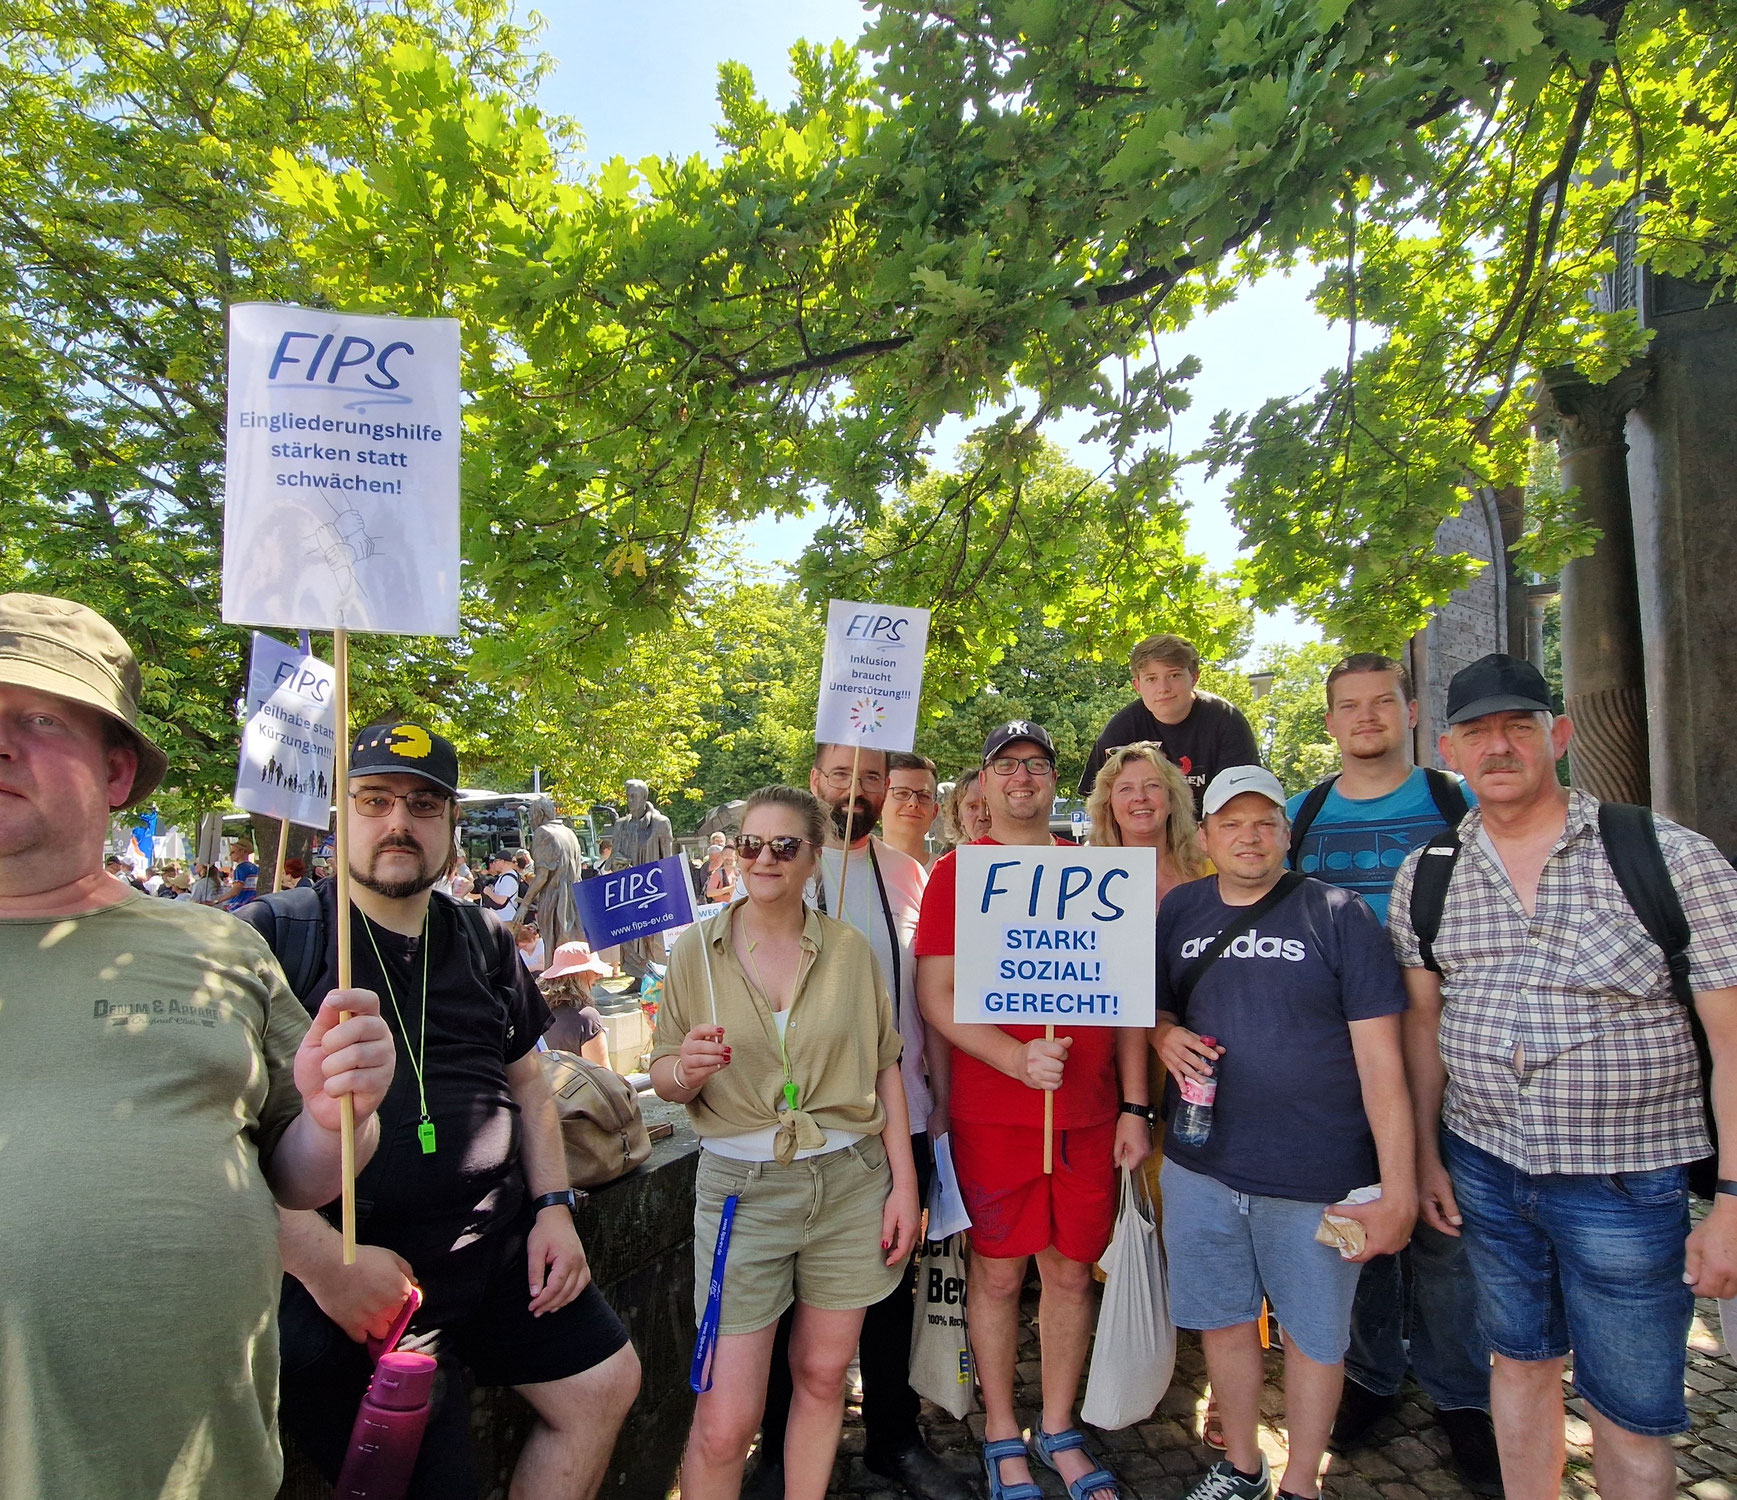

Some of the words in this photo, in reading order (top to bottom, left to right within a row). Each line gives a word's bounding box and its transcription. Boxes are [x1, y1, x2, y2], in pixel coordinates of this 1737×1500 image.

[268, 331, 415, 390] FIPS
[239, 411, 444, 443] Eingliederungshilfe
[271, 442, 350, 463] stärken
[356, 448, 408, 469] statt
[276, 470, 402, 495] schwächen!
[846, 614, 909, 641] FIPS
[850, 654, 897, 669] Inklusion
[273, 660, 330, 703] FIPS
[851, 669, 892, 683] braucht
[828, 682, 911, 701] Unterstützung!!!
[257, 699, 311, 730] Teilhabe
[313, 722, 335, 742] statt
[1007, 720, 1030, 735] NY
[258, 722, 332, 760] Kürzungen!!!
[1073, 813, 1080, 822] P
[605, 867, 663, 907] FIPS
[980, 860, 1130, 922] FIPS
[610, 912, 675, 937] www.fips-ev.de
[1006, 929, 1097, 950] STARK!
[1000, 959, 1101, 982] SOZIAL!
[152, 999, 164, 1013] &
[984, 992, 1119, 1016] GERECHT!
[927, 1314, 947, 1327] 100%
